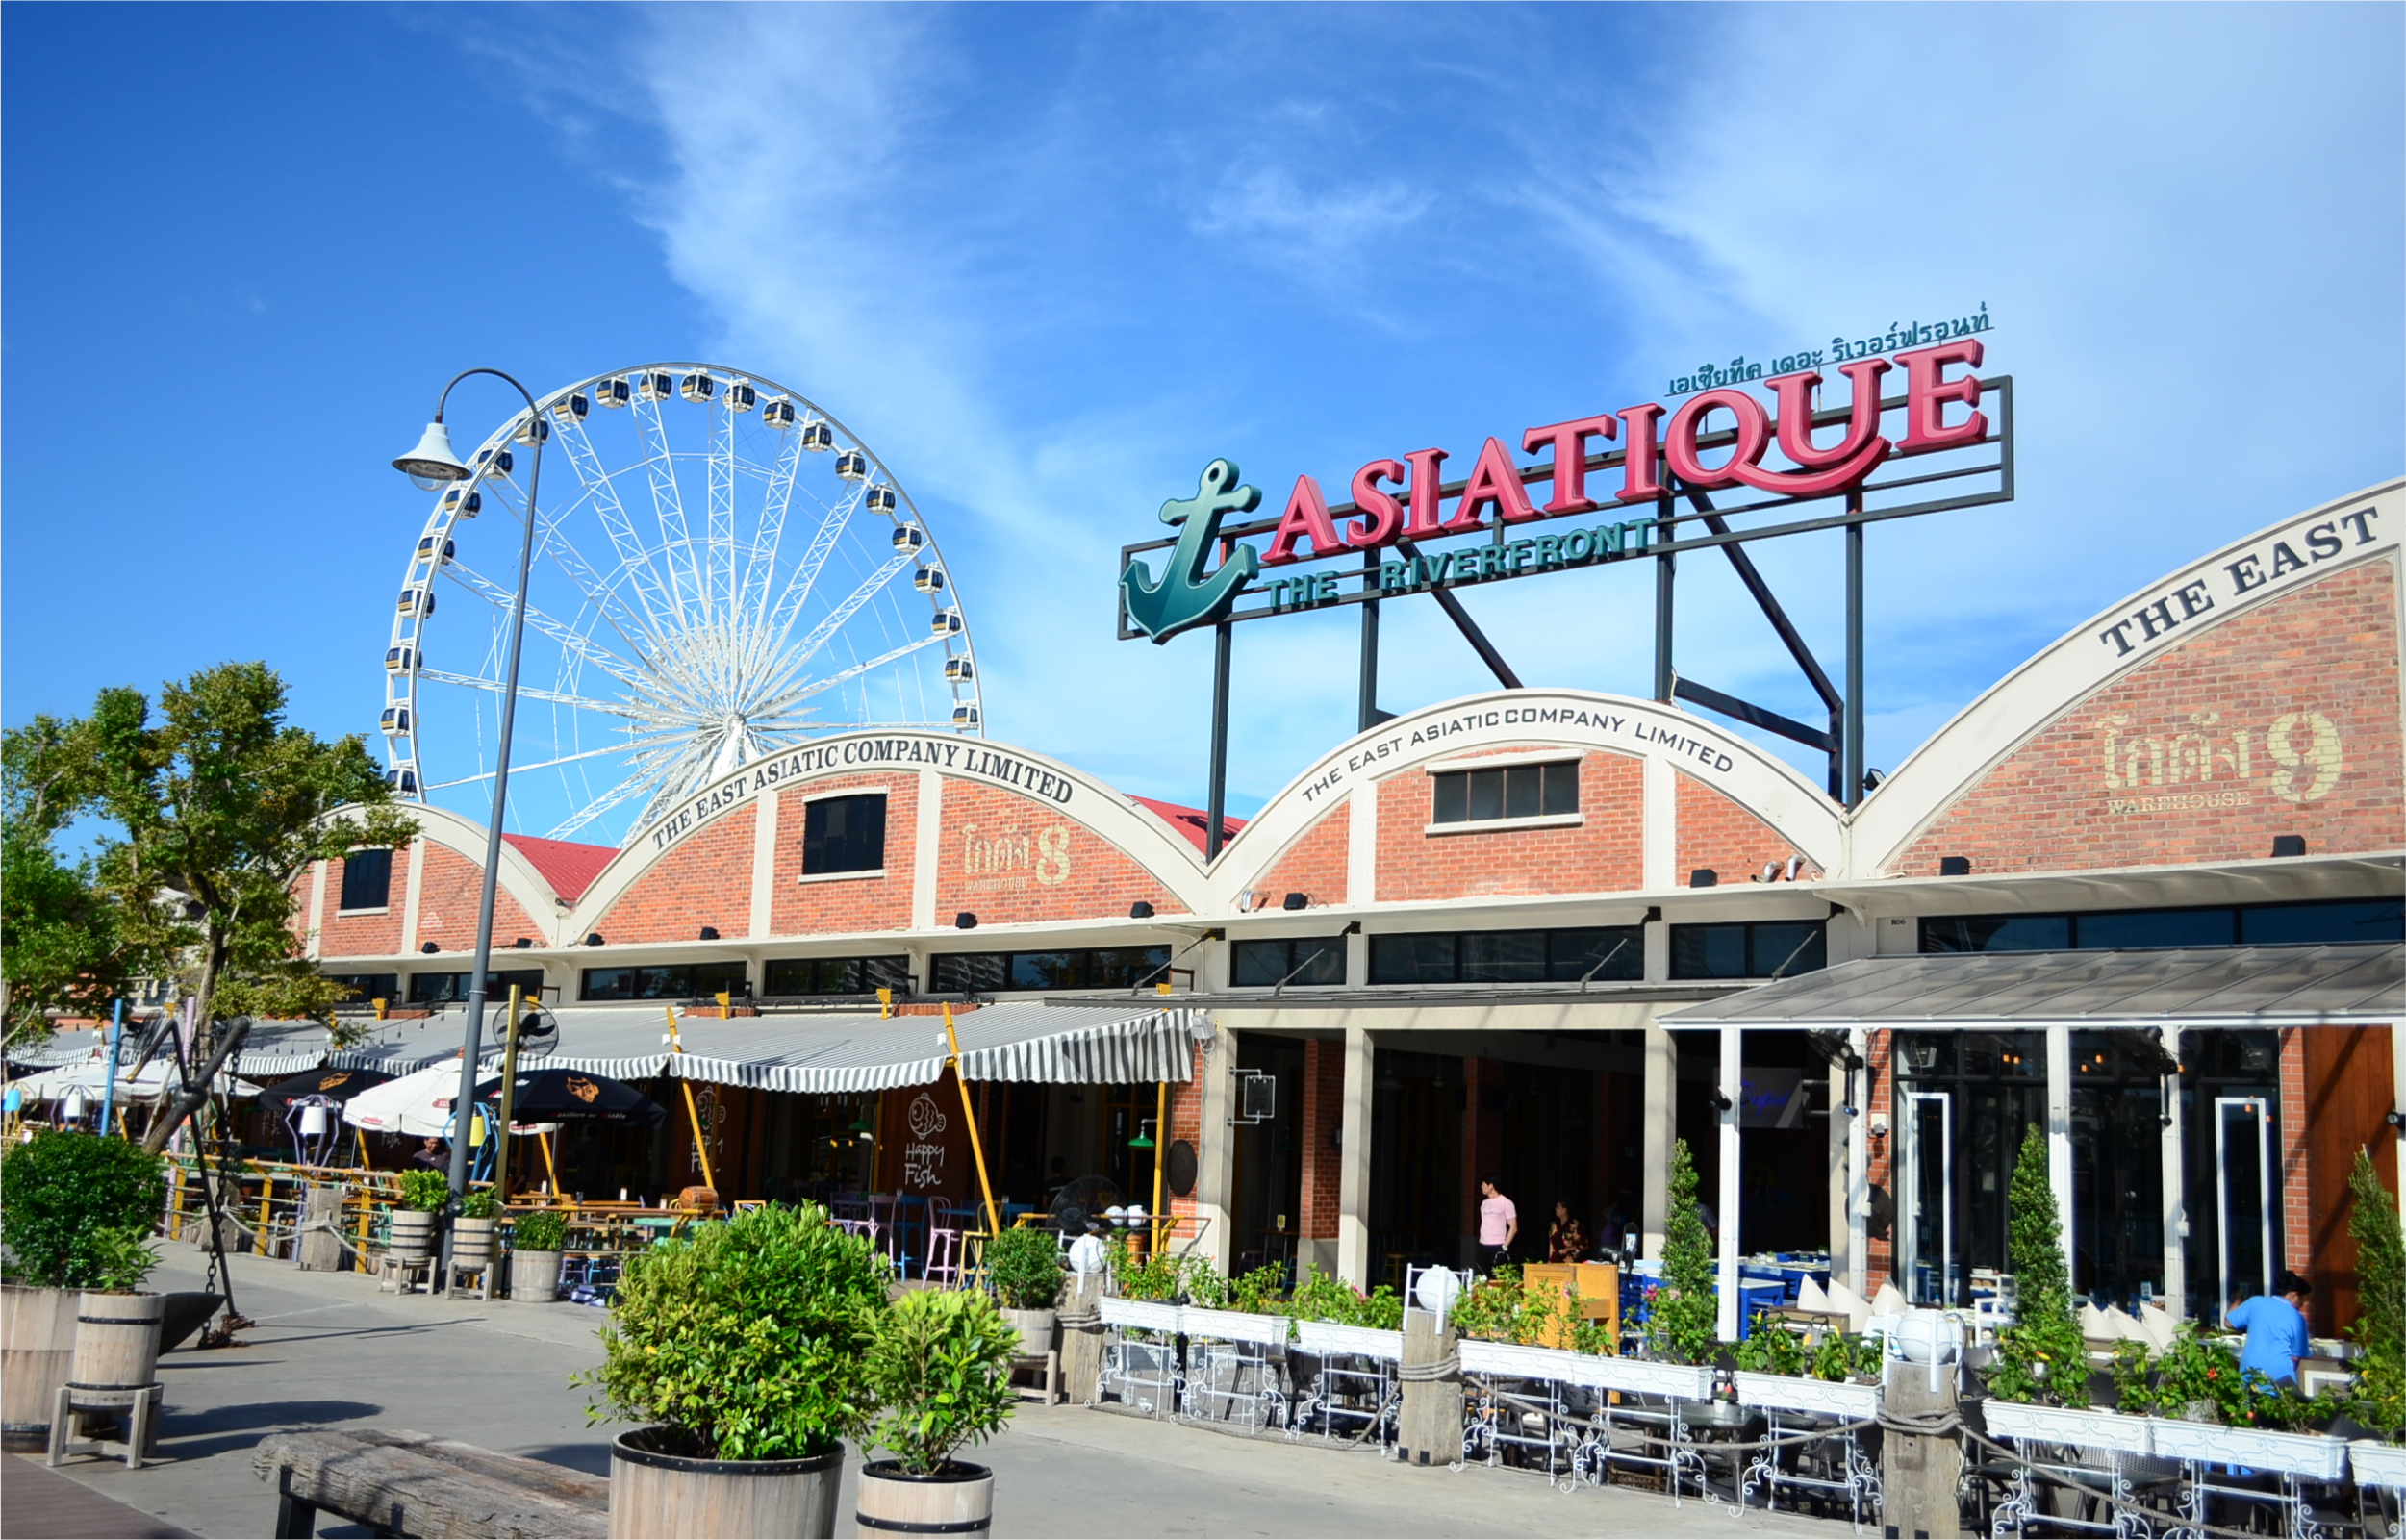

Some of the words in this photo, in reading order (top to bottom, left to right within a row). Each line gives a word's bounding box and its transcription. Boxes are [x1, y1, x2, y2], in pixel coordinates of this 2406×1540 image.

[1771, 349, 1823, 375] เดอะ
[1831, 300, 1990, 362] ริเวอร์ฟรอนท์
[1261, 338, 1988, 566] ASIATIQUE
[1265, 570, 1339, 610] THE
[1380, 517, 1659, 593] RIVERFRONT
[2098, 578, 2215, 659] THE
[2222, 506, 2379, 596] EAST
[652, 813, 694, 850] THE
[696, 777, 747, 821] EAST
[753, 745, 839, 788] ASIATIC
[843, 739, 960, 768] COMPANY
[964, 748, 1074, 805] LIMITED
[1301, 767, 1342, 802] THE
[1347, 737, 1403, 773] EAST
[1409, 711, 1500, 747] ASIATIC
[1505, 708, 1626, 733] COMPANY
[1635, 722, 1734, 773] LIMITED
[2267, 711, 2343, 803] 9
[2106, 791, 2250, 814] WAREHOUSE
[964, 877, 1028, 891] WAREHOUSE
[1036, 825, 1071, 885] 8
[904, 1163, 942, 1189] Fish
[905, 1142, 945, 1168] Happy
